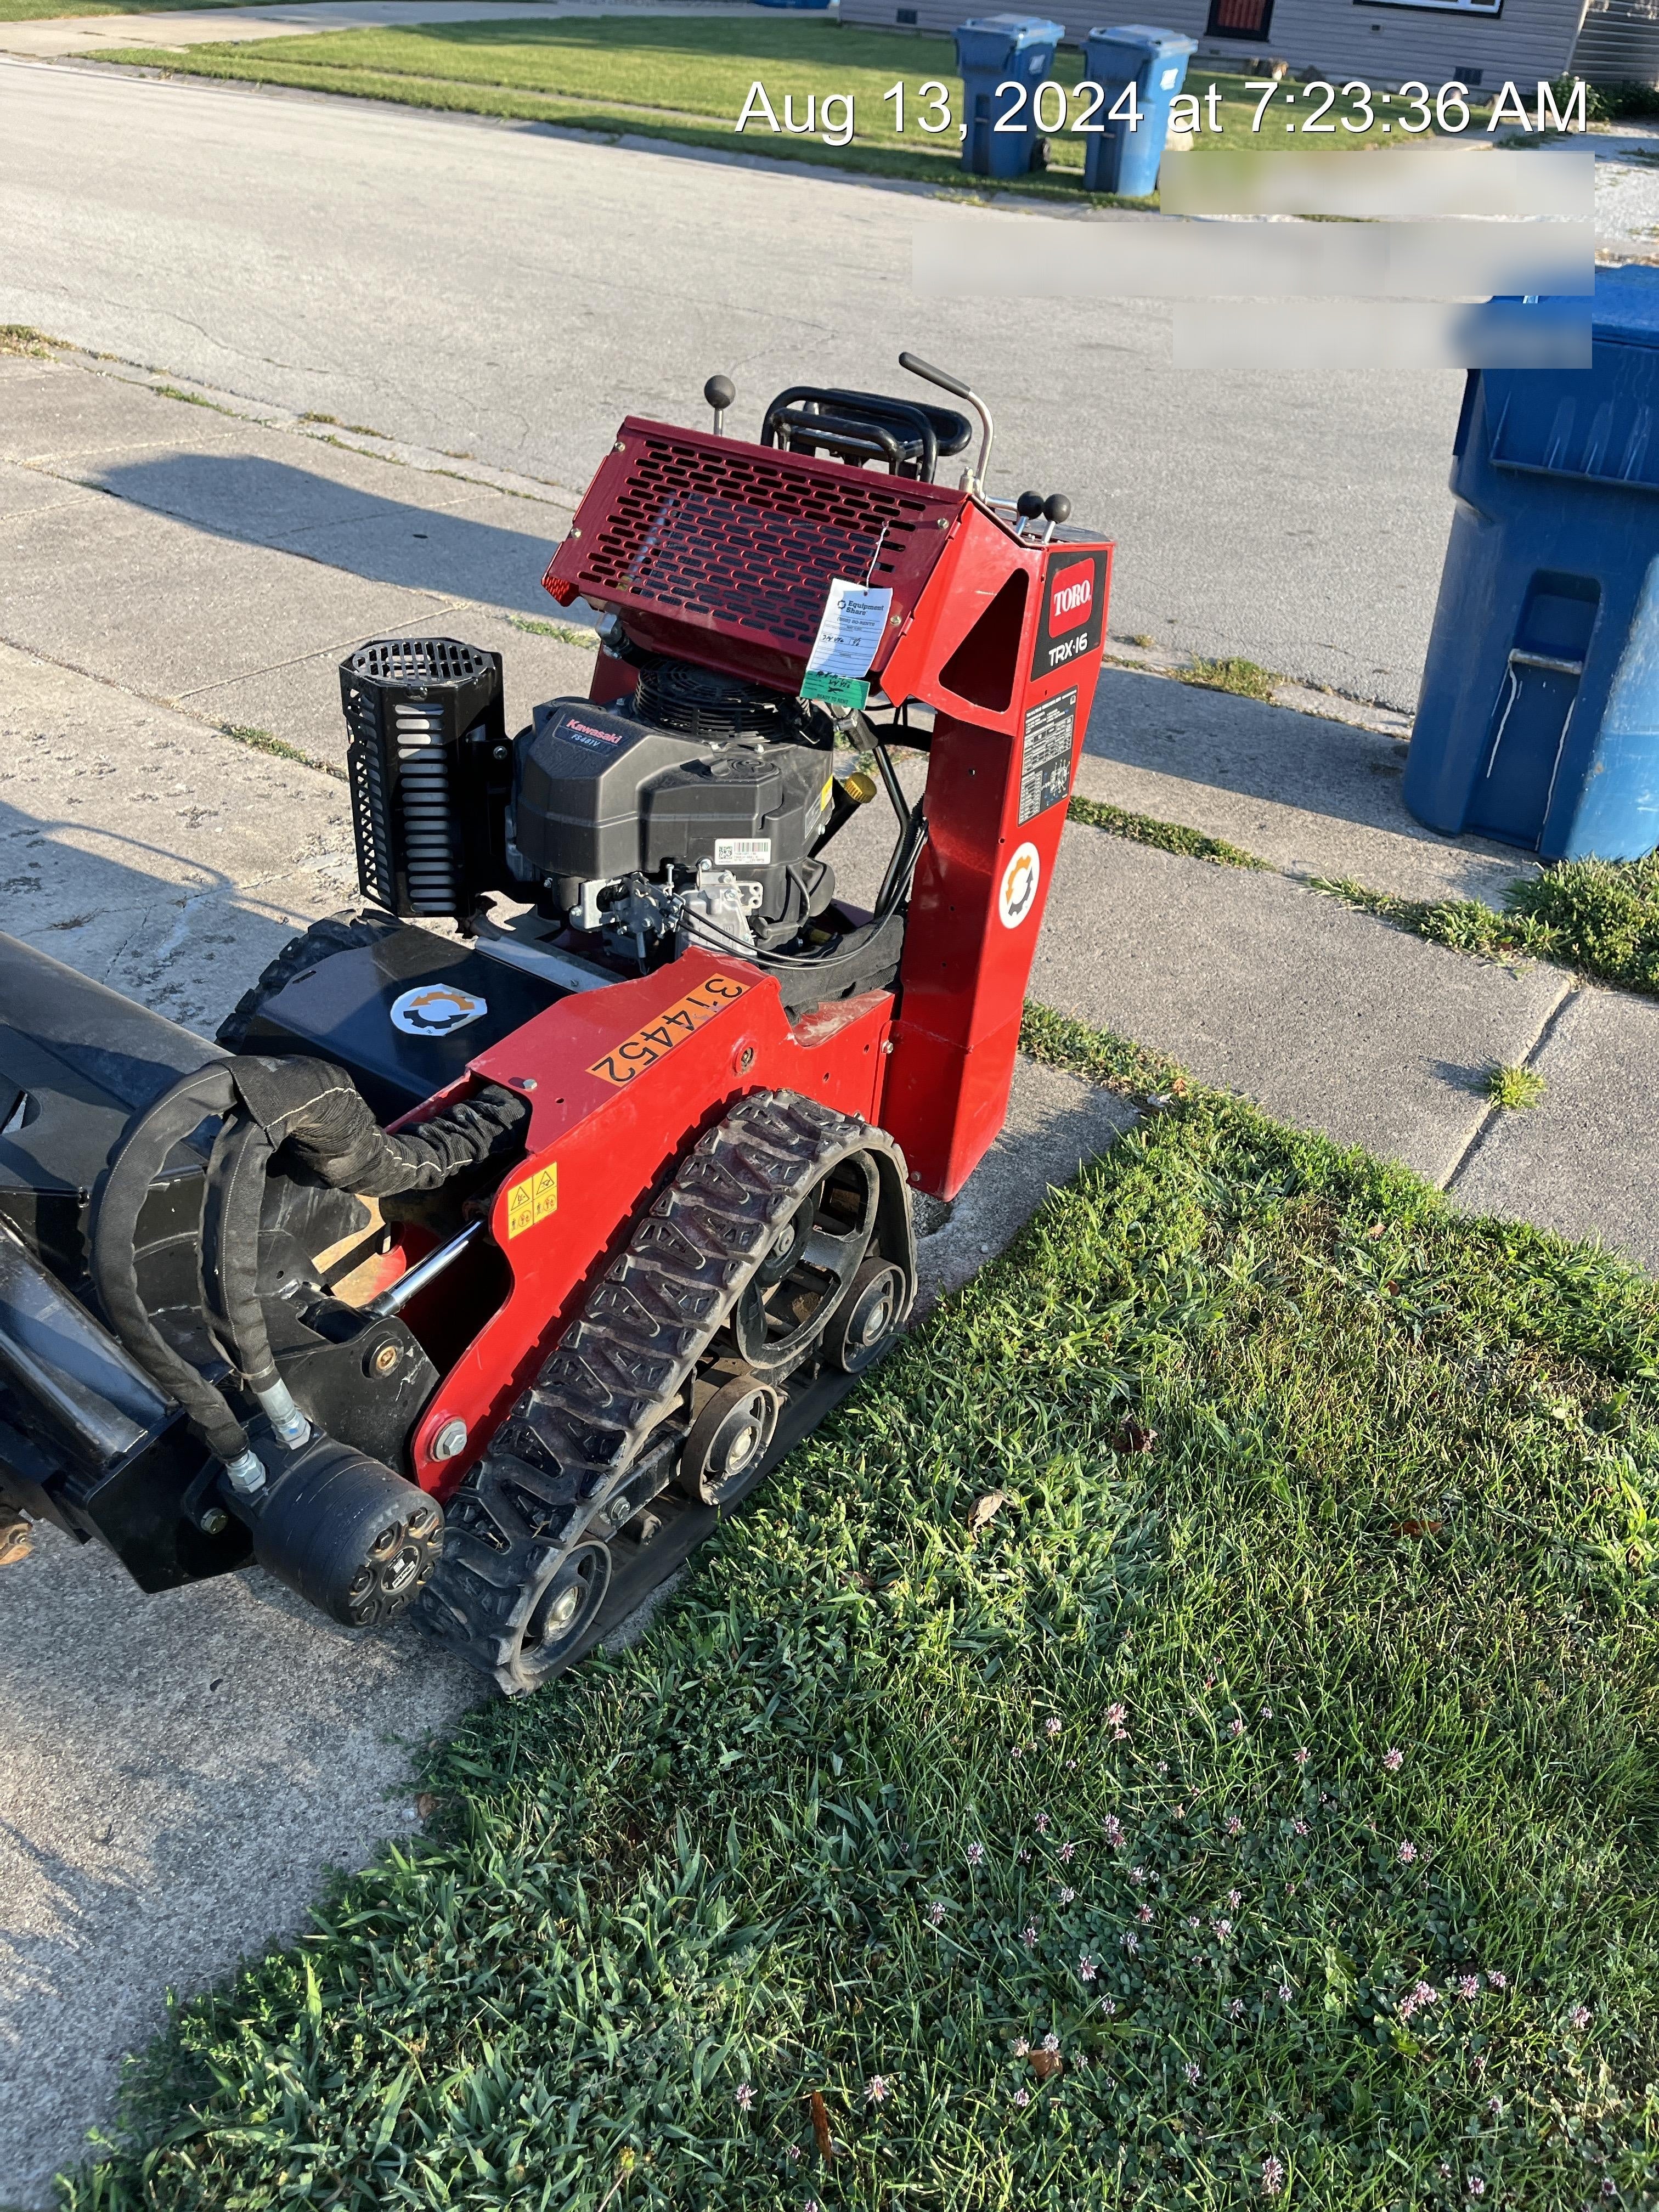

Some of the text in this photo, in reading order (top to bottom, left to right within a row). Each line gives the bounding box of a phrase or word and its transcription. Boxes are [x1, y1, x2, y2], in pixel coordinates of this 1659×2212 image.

[846, 607, 867, 616] Share
[848, 600, 884, 611] Equipment
[1053, 579, 1092, 617] TORO
[1048, 632, 1088, 667] TRX-16
[566, 719, 623, 744] Kawasaki
[591, 978, 743, 1082] 314452
